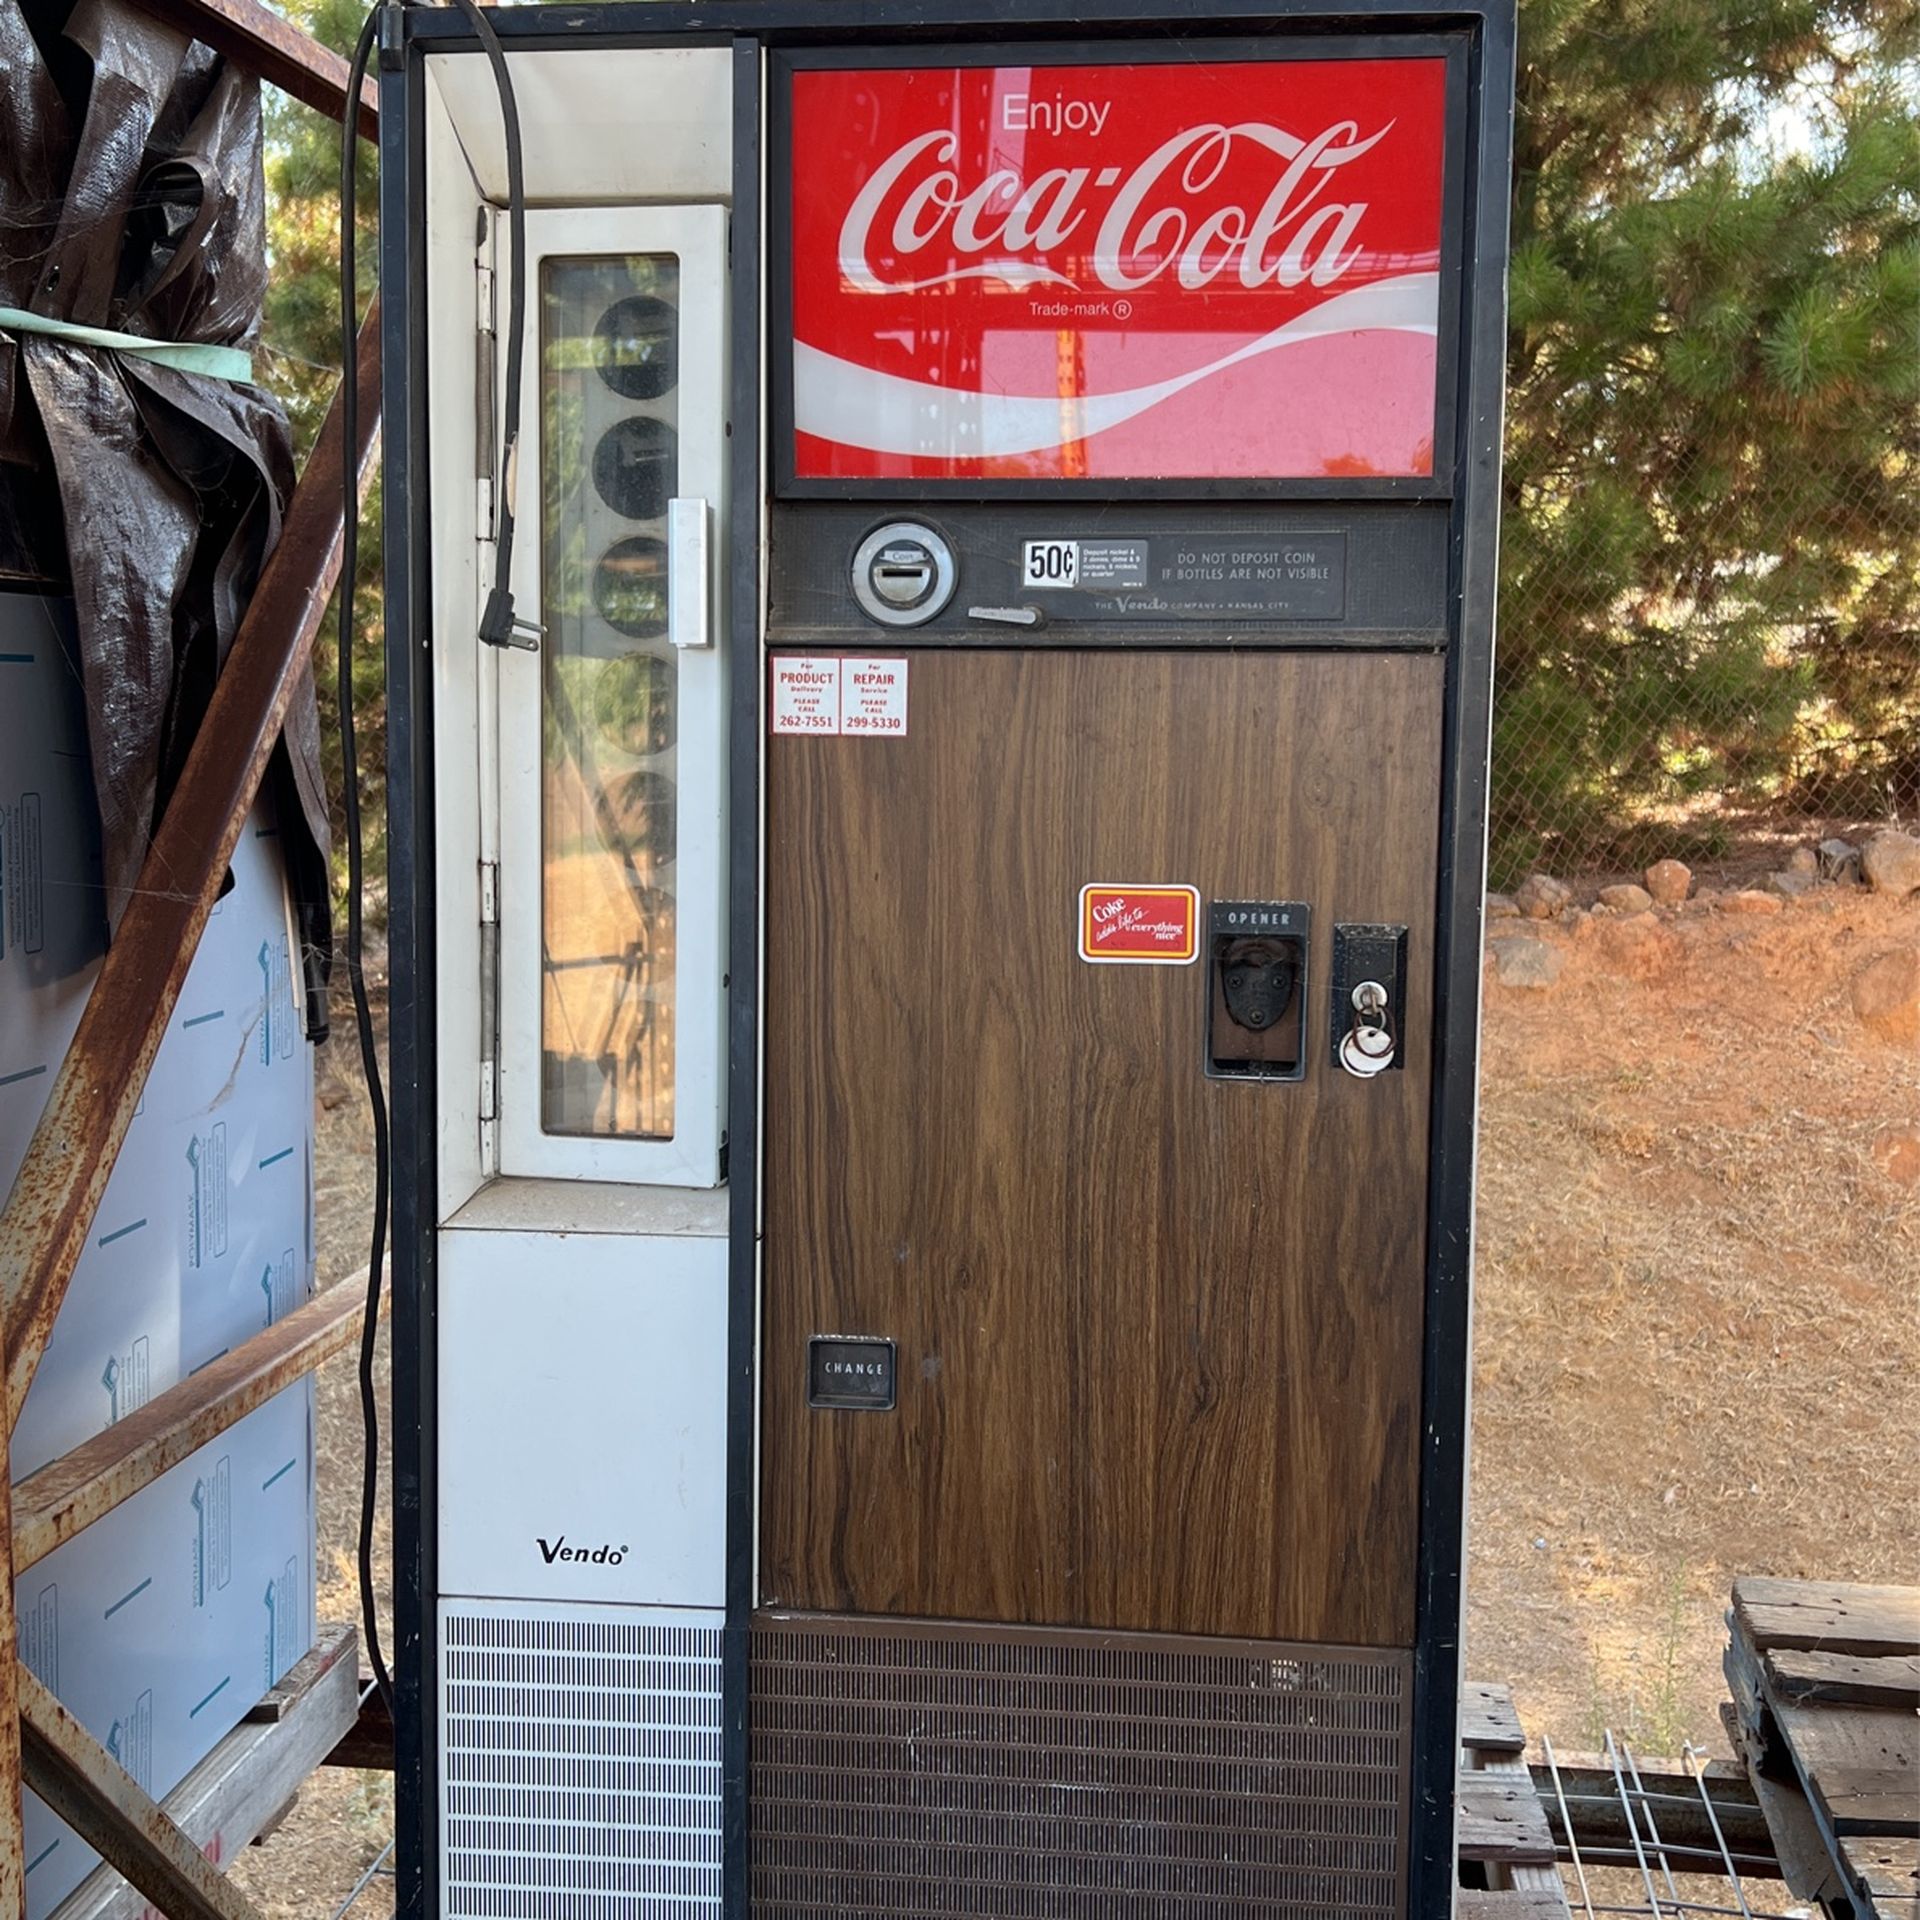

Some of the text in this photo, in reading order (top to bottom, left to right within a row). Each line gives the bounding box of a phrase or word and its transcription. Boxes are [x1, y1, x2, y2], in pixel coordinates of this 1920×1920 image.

[1003, 93, 1111, 137] Enjoy
[838, 117, 1397, 293] Coca-Cola
[1029, 302, 1110, 317] Trade-mark
[1030, 545, 1073, 579] 50¢
[1177, 553, 1316, 564] DO NOT DEPOSIT COIN
[1162, 568, 1329, 580] IF BOTTLES ARE NOT VISIBLE
[1095, 602, 1113, 610] THE
[1115, 595, 1168, 613] Vendo
[780, 672, 834, 684] PRODUCT
[853, 673, 895, 685] REPAIR
[780, 715, 833, 728] 262-7551
[846, 716, 901, 729] 299-5330
[1092, 898, 1127, 923] Coke
[1228, 912, 1290, 925] OPENER
[1131, 921, 1184, 937] everything
[824, 1361, 883, 1375] CHANGE
